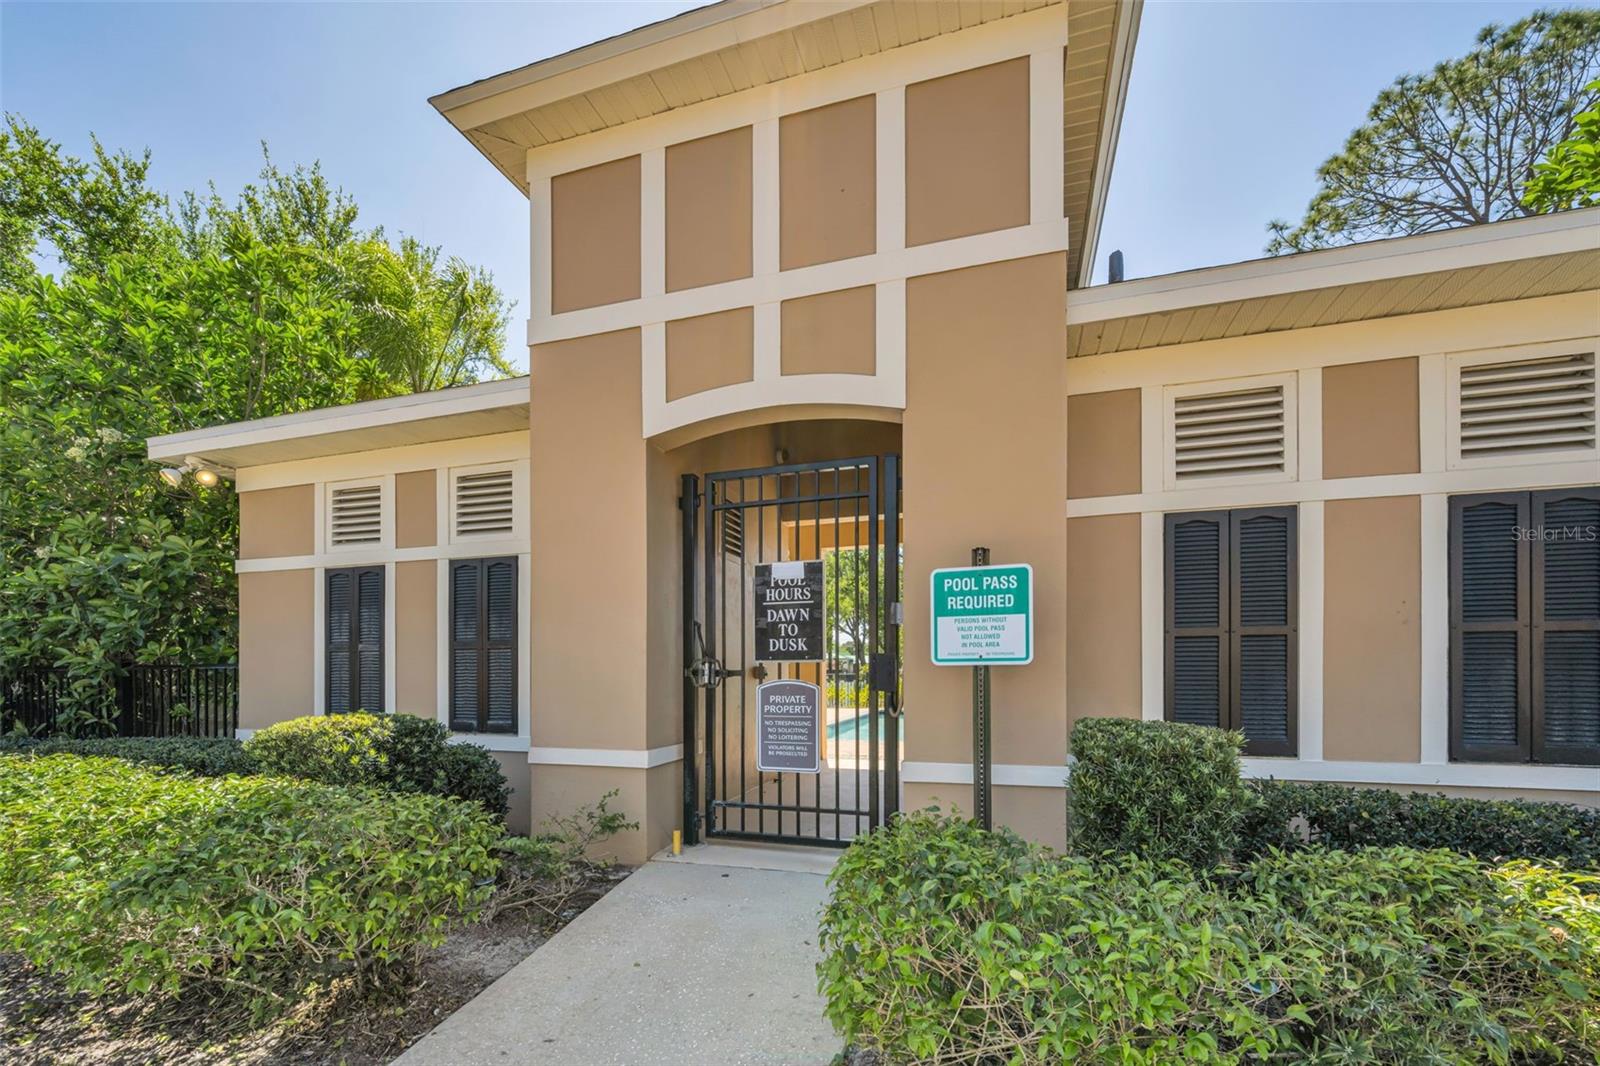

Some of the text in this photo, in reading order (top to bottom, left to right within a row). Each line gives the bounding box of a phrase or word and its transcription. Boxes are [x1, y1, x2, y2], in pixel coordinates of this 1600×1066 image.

[770, 577, 806, 587] POOL
[943, 575, 1018, 592] POOL PASS
[766, 587, 811, 601] HOURS
[947, 594, 1014, 610] REQUIRED
[767, 608, 810, 622] DAWN
[778, 623, 798, 636] TO
[769, 638, 808, 652] DUSK
[769, 695, 806, 704] PRIVATE
[764, 705, 812, 714] PROPERTY
